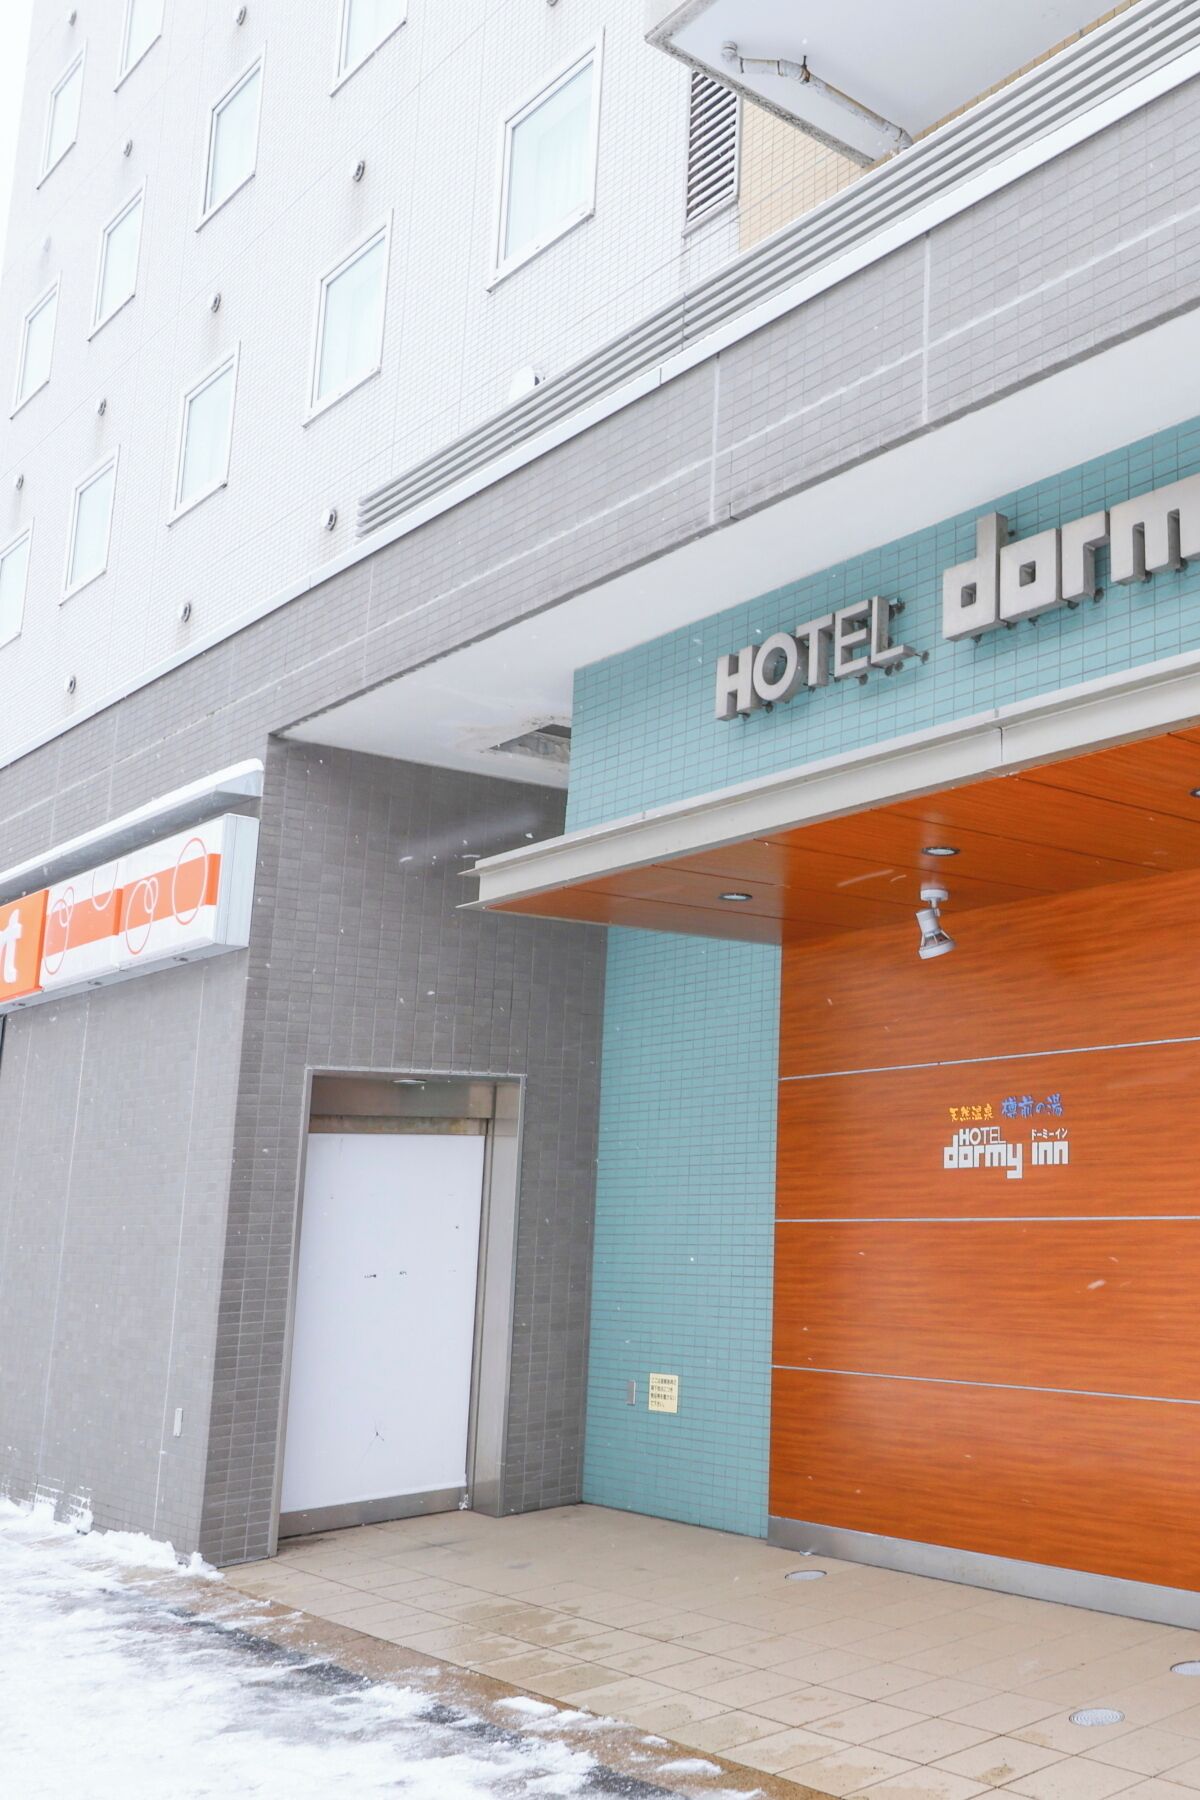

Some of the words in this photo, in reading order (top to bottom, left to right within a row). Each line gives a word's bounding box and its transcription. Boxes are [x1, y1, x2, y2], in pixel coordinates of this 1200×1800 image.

[715, 596, 911, 721] HOTEL
[949, 1103, 994, 1122] 天然温泉
[959, 1126, 1006, 1146] HOTEL
[1031, 1128, 1068, 1141] ドーミーイン
[943, 1135, 1023, 1179] dormy
[1031, 1141, 1069, 1165] inn
